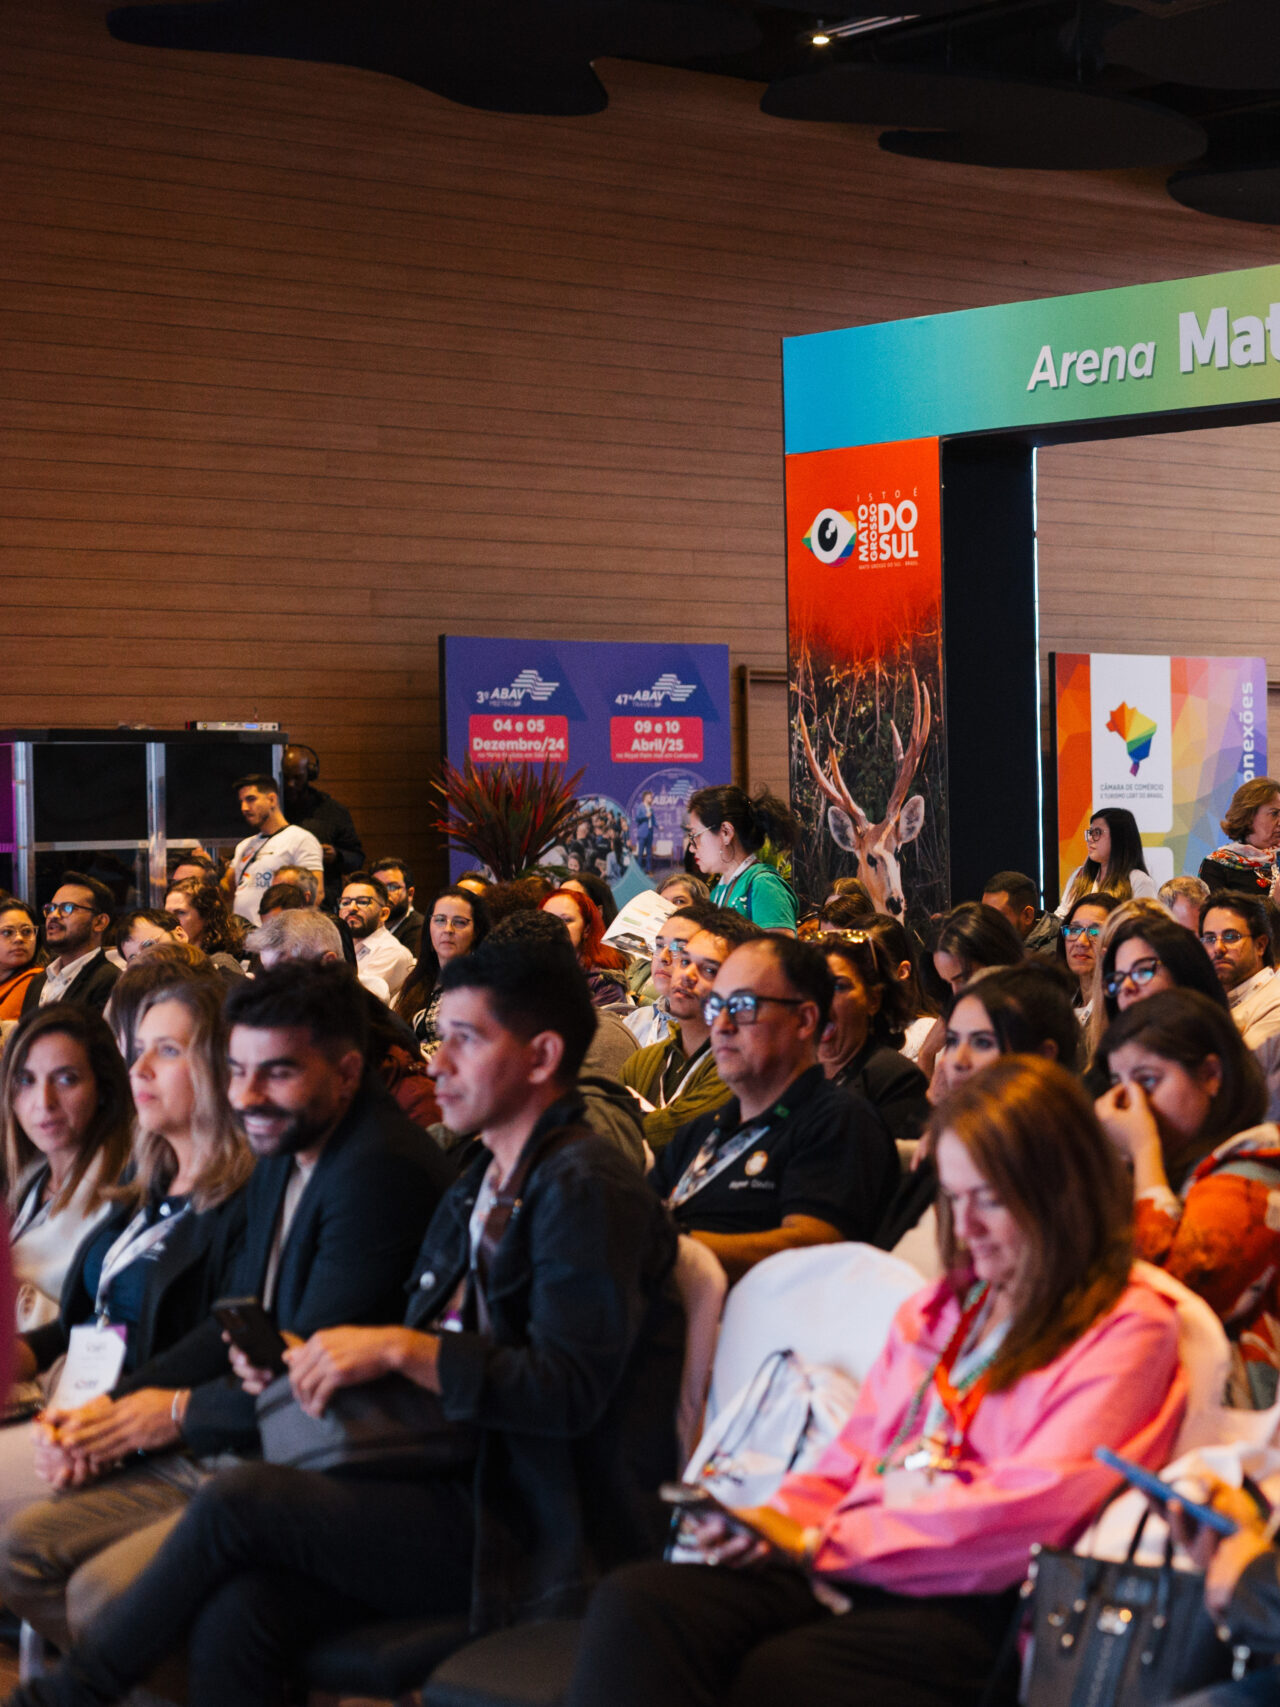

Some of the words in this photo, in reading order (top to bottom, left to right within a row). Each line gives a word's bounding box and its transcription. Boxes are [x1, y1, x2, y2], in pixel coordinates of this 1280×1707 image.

[1027, 340, 1155, 392] Arena
[878, 499, 918, 534] DO
[858, 504, 869, 562] MATO
[869, 503, 878, 562] GROSSO
[879, 532, 919, 560] SUL
[490, 687, 525, 699] ABAV
[633, 690, 665, 701] ABAV
[493, 719, 512, 732] 04
[515, 721, 524, 732] e
[527, 719, 545, 733] 05
[634, 720, 652, 734] 09
[654, 722, 662, 733] e
[666, 721, 680, 734] 10
[473, 736, 565, 752] Dezembro/24
[631, 738, 683, 754] Abril/25
